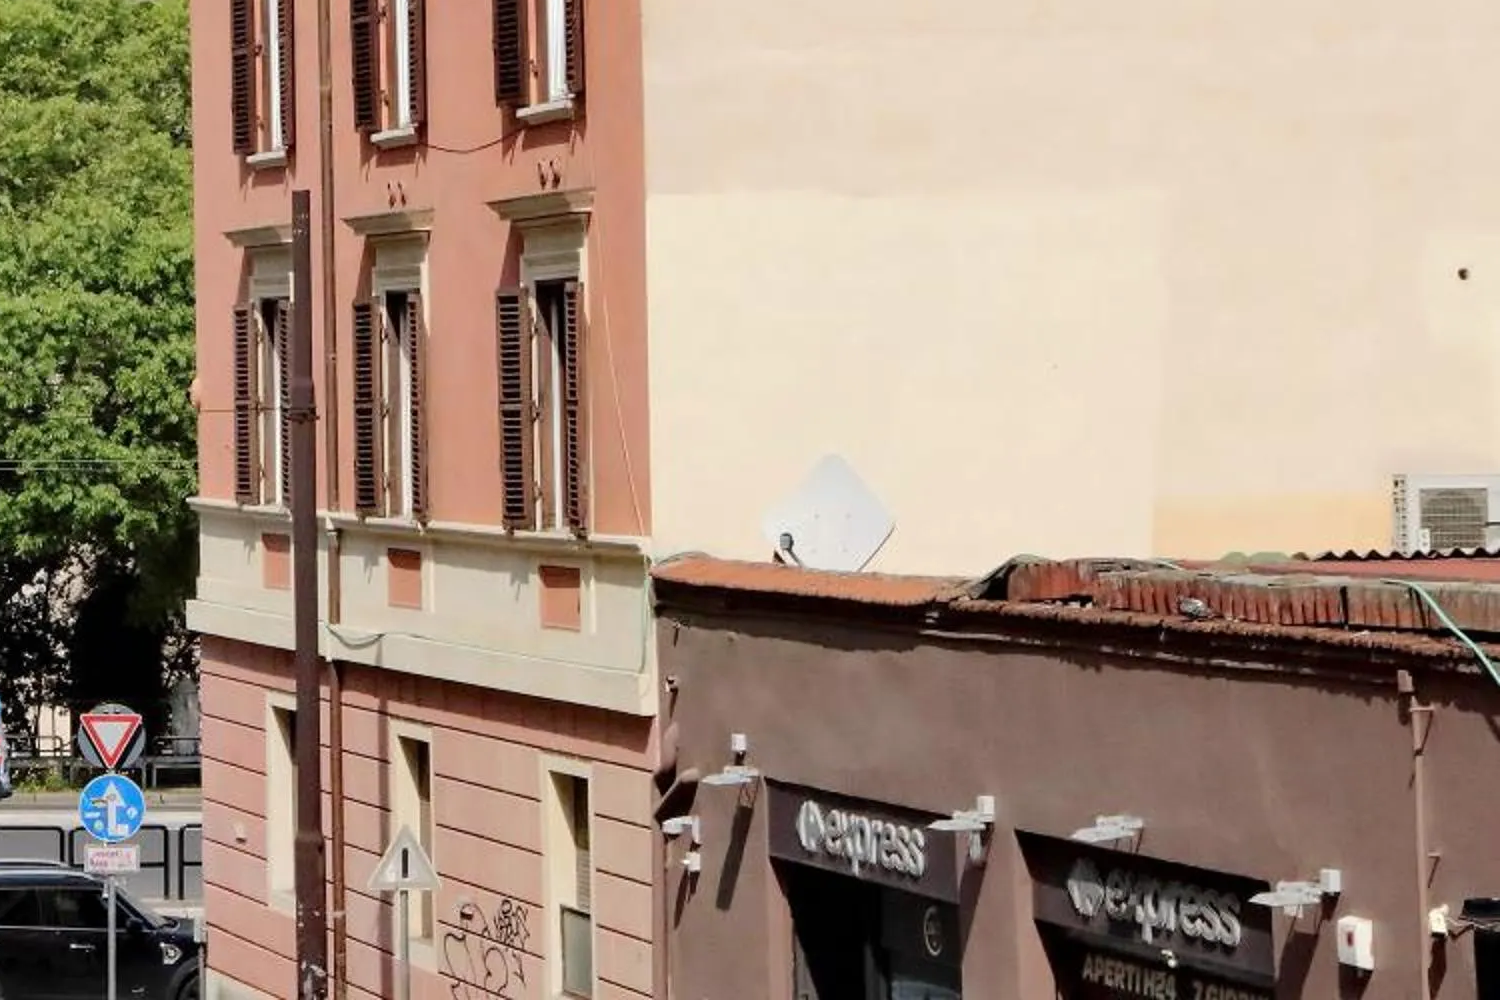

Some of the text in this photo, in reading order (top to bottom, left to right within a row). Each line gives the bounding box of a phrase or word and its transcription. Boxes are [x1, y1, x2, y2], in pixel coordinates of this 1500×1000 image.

[825, 808, 925, 876] express
[1105, 868, 1242, 947] express
[1081, 953, 1140, 993] APERTI
